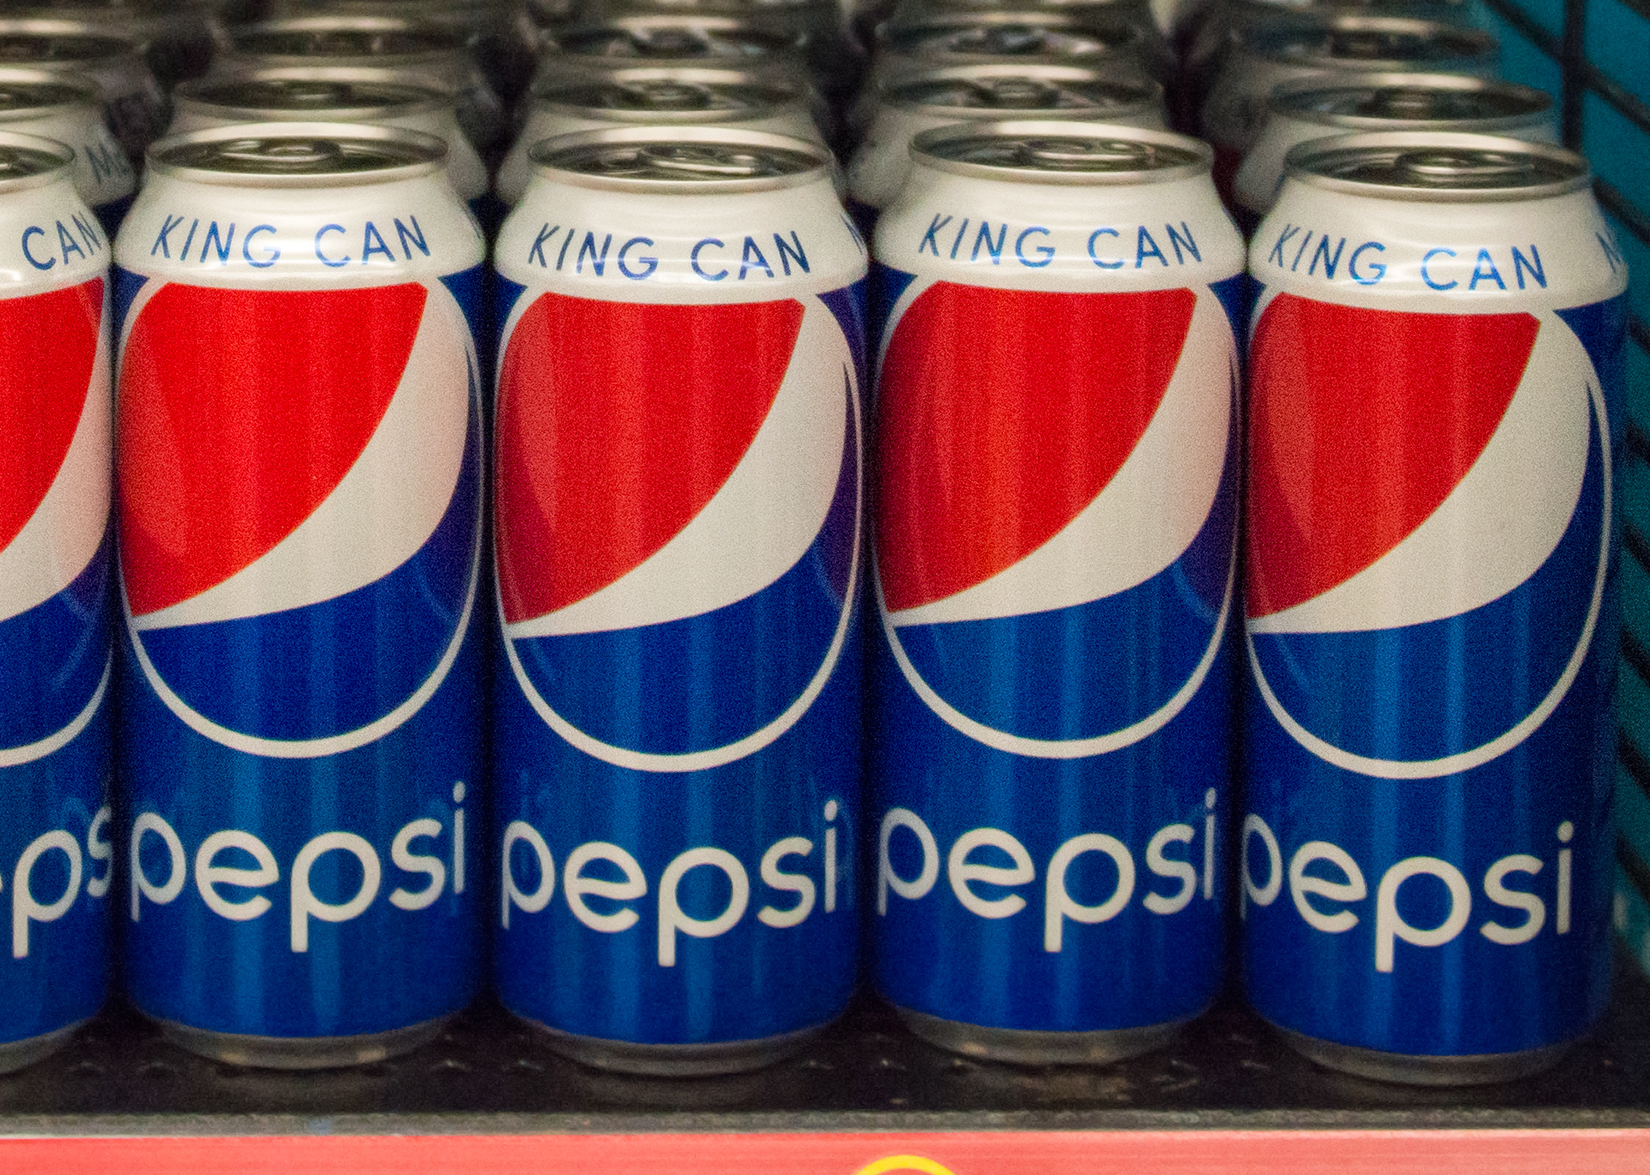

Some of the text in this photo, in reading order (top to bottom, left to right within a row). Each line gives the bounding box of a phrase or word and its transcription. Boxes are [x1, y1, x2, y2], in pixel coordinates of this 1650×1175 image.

[21, 206, 104, 272] CAN
[150, 212, 433, 270] KING CAN
[527, 221, 660, 282] KING
[689, 228, 812, 283] CAN
[917, 211, 1057, 270] KING
[1086, 220, 1203, 272] CAN
[1267, 223, 1389, 287] KING
[1419, 242, 1550, 293] CAN
[130, 780, 466, 953] pepsi
[501, 799, 838, 968] pepsi
[876, 787, 1217, 953] pepsi
[1241, 813, 1574, 973] pepsi
